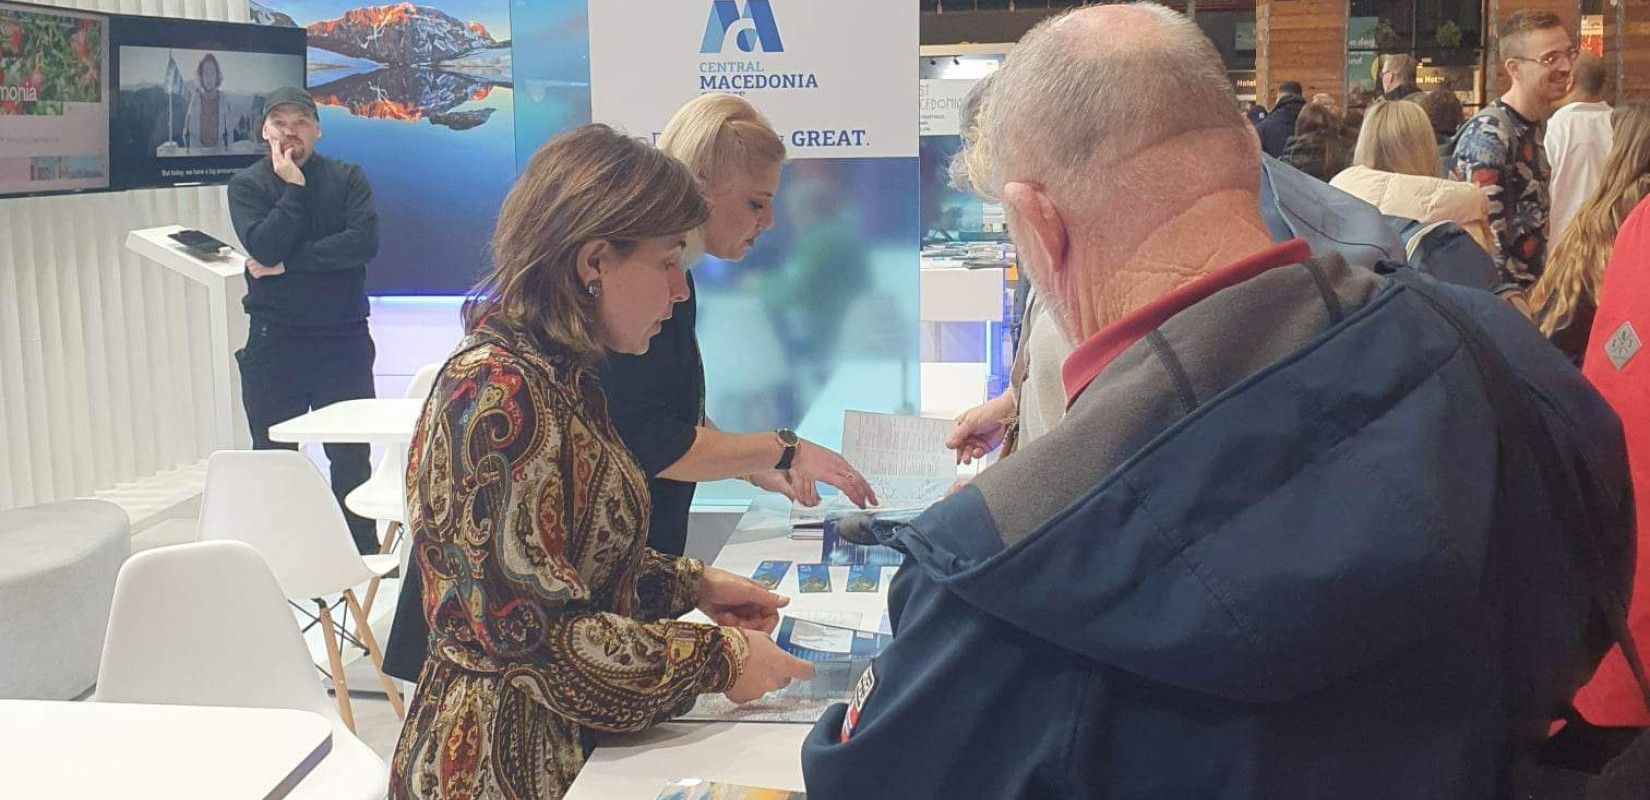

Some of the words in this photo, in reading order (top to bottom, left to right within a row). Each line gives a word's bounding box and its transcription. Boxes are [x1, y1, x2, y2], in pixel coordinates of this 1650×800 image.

[699, 61, 764, 73] CENTRAL
[699, 74, 819, 90] MACEDONIA
[791, 129, 870, 147] GREAT.
